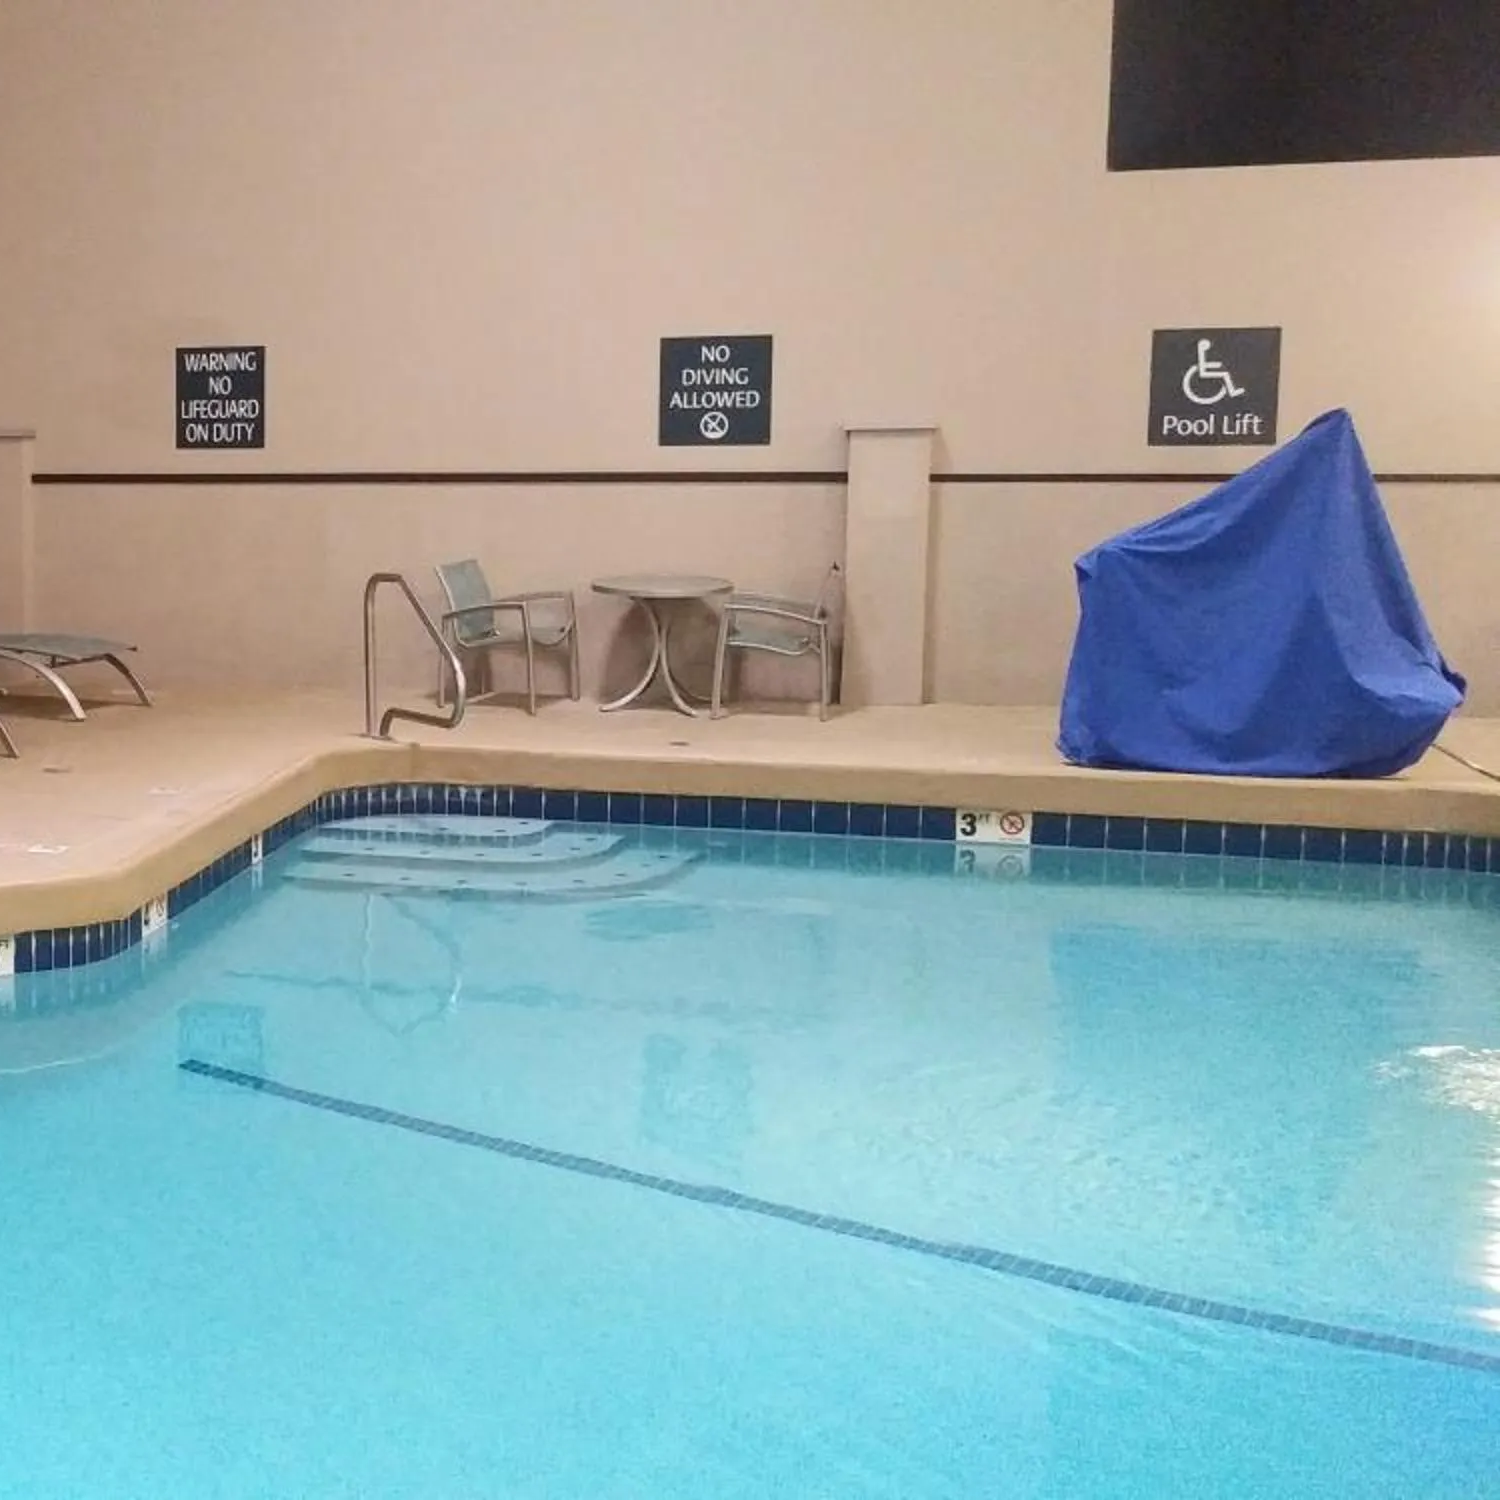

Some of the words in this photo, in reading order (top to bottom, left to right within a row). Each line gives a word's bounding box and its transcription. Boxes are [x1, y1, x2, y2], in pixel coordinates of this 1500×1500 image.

[184, 351, 257, 372] WARNING
[701, 345, 731, 363] NO
[208, 375, 232, 395] NO
[681, 367, 749, 386] DIVING
[181, 399, 260, 419] LIFEGUARD
[668, 390, 761, 409] ALLOWED
[185, 422, 210, 442] ON
[213, 422, 255, 442] DUTY
[1162, 413, 1215, 436] Pool
[1222, 413, 1264, 435] Lift
[960, 813, 977, 837] 3
